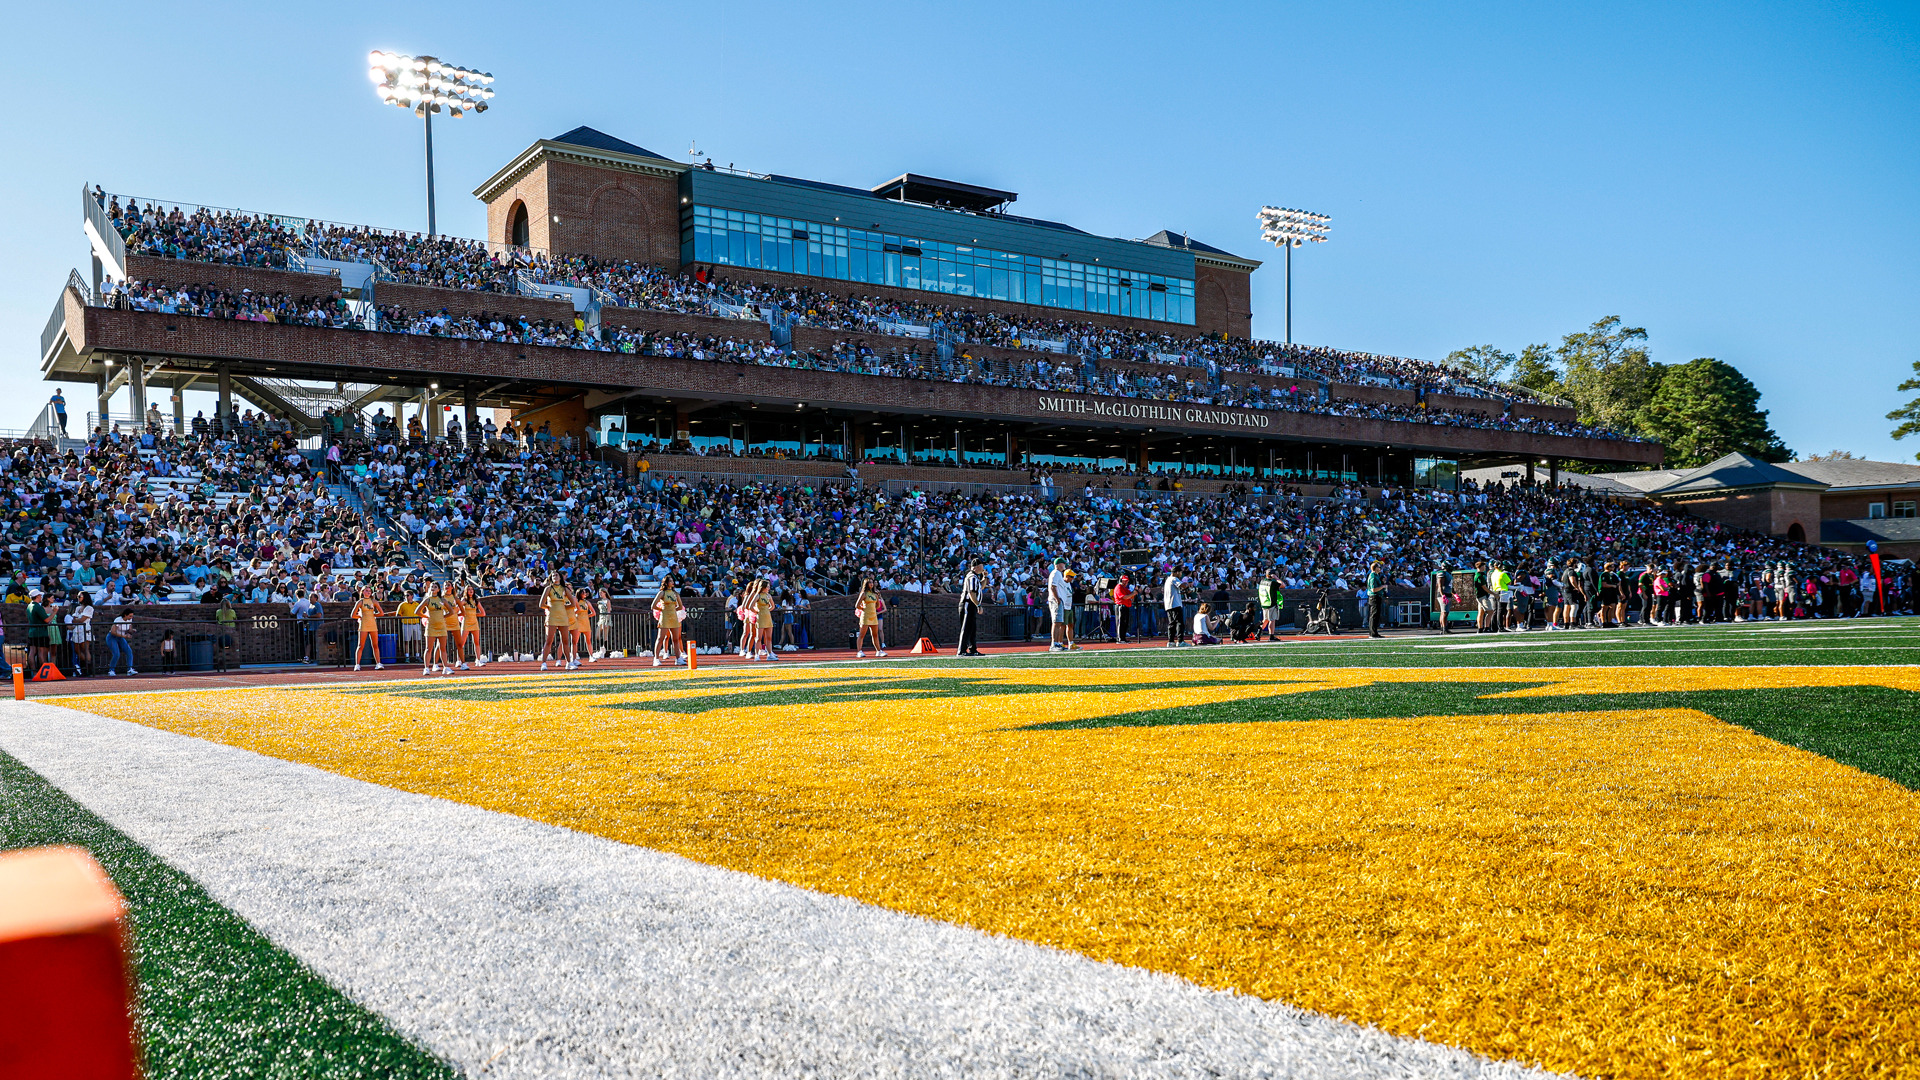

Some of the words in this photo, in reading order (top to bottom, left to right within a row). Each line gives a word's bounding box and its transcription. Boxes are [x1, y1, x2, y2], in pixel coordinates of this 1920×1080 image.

[1185, 408, 1269, 428] GRANDSTAND
[686, 607, 705, 620] 107
[251, 614, 279, 629] 108
[922, 639, 933, 651] 10
[40, 665, 50, 679] G
